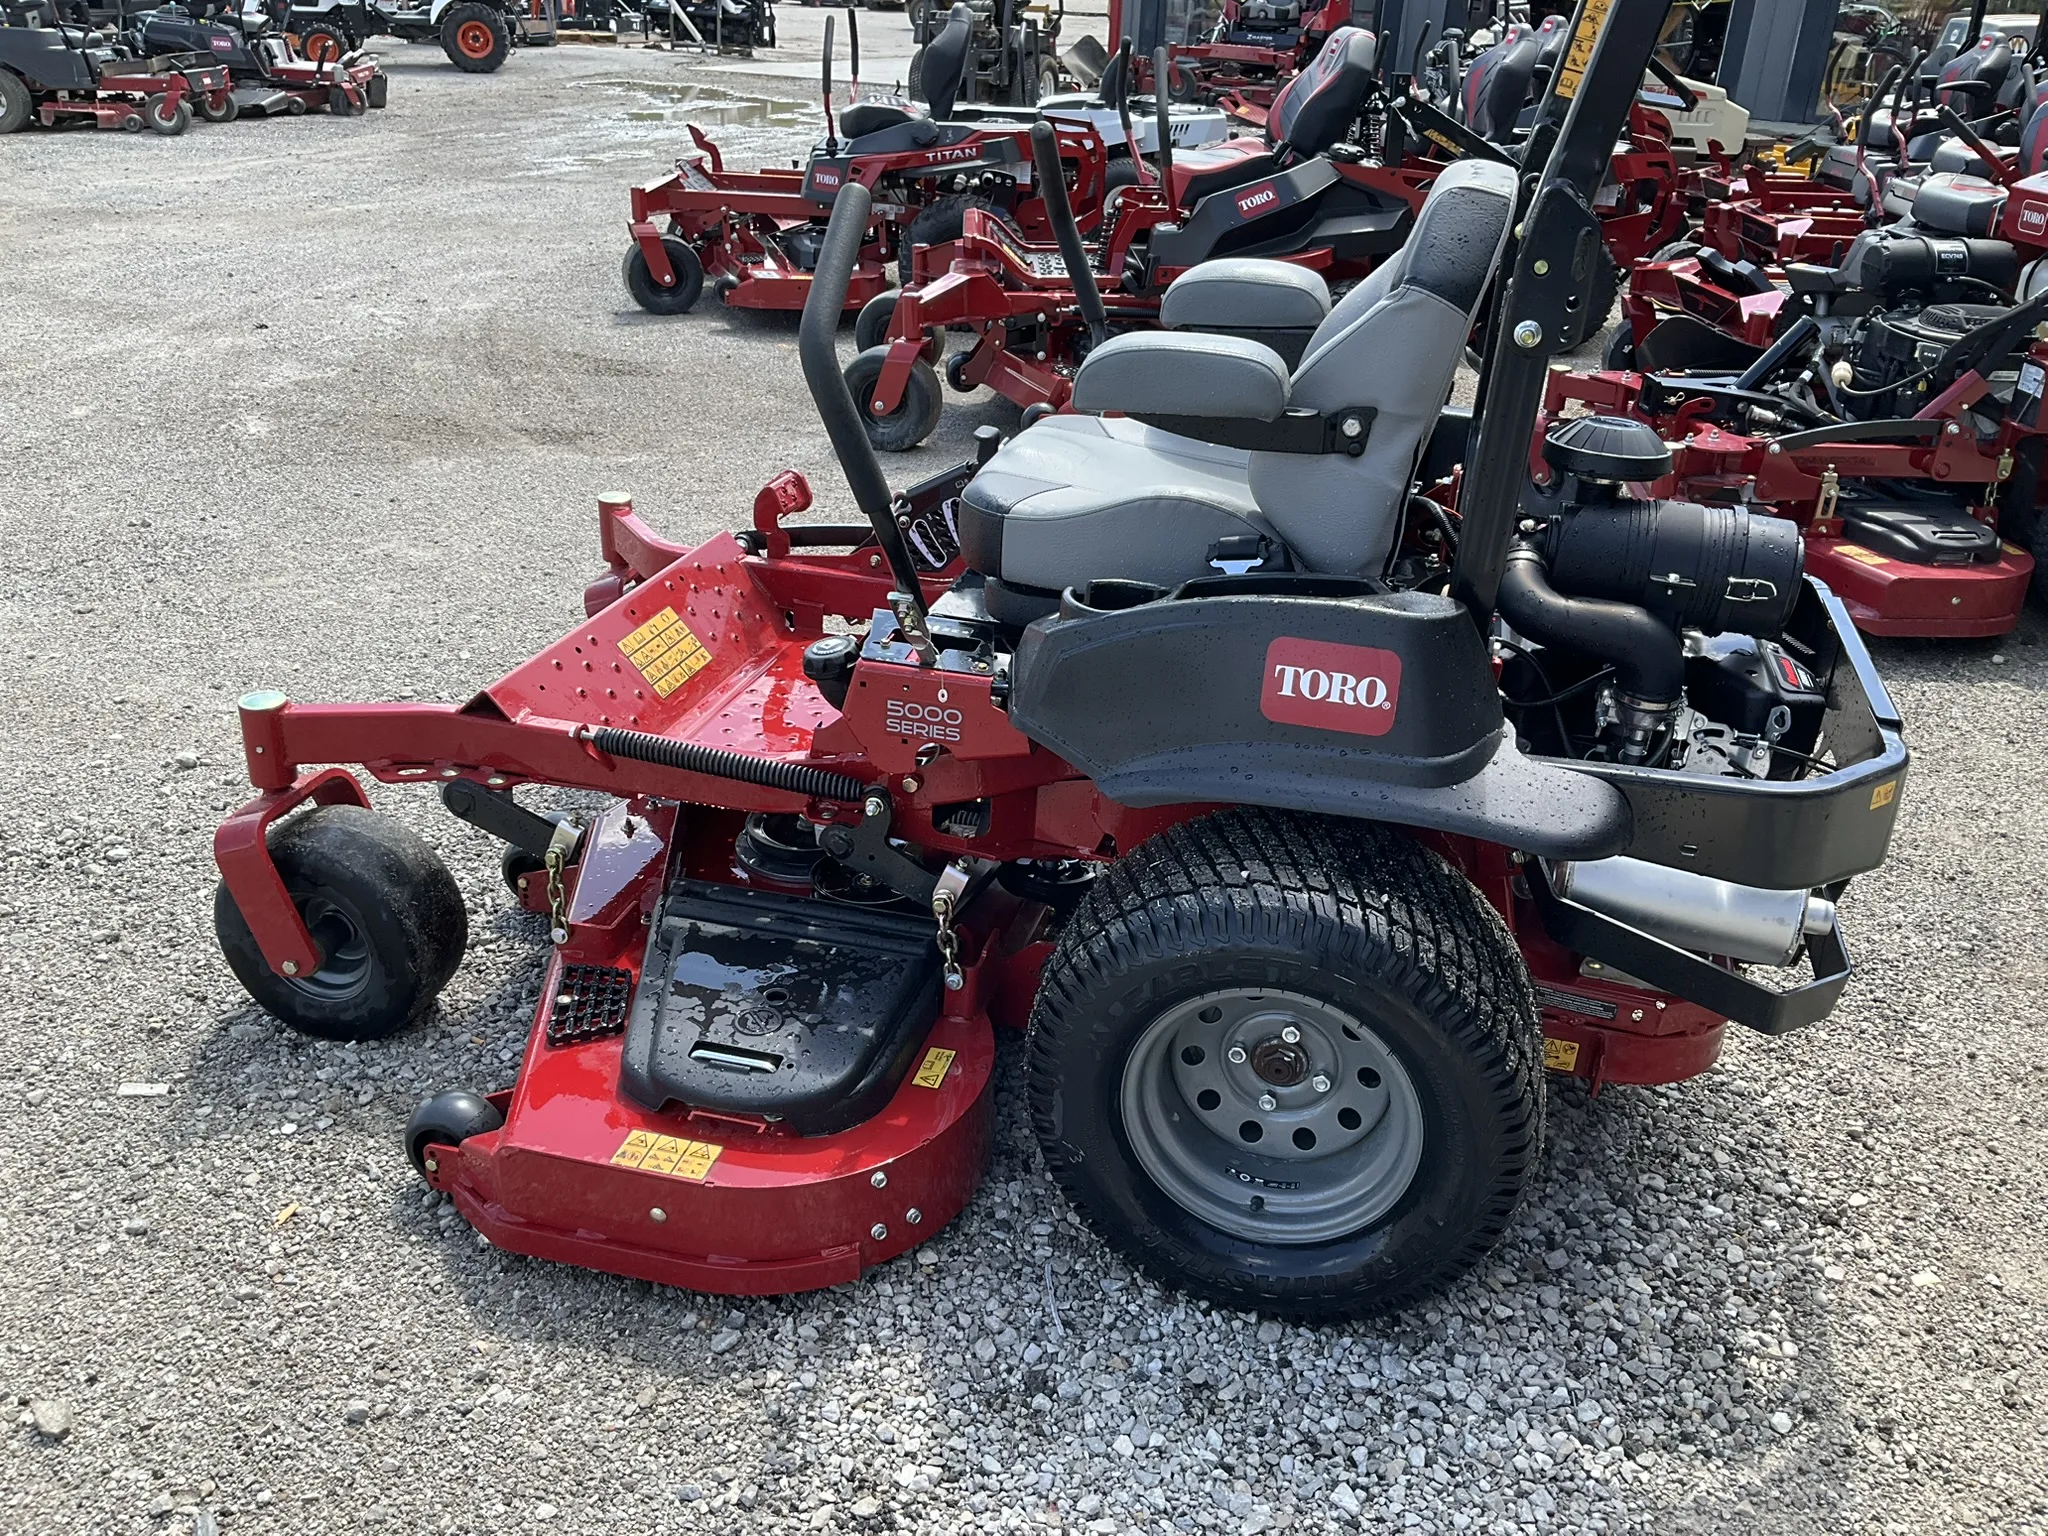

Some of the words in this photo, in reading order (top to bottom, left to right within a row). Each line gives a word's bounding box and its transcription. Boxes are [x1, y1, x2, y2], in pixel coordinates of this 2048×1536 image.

[212, 40, 231, 48] TORO
[925, 147, 977, 162] TITAN
[815, 173, 838, 186] TORO
[1238, 190, 1274, 211] TORO
[2023, 210, 2045, 225] TORO
[1274, 665, 1388, 708] TORO
[886, 699, 963, 725] 5000
[886, 718, 961, 742] SERIES
